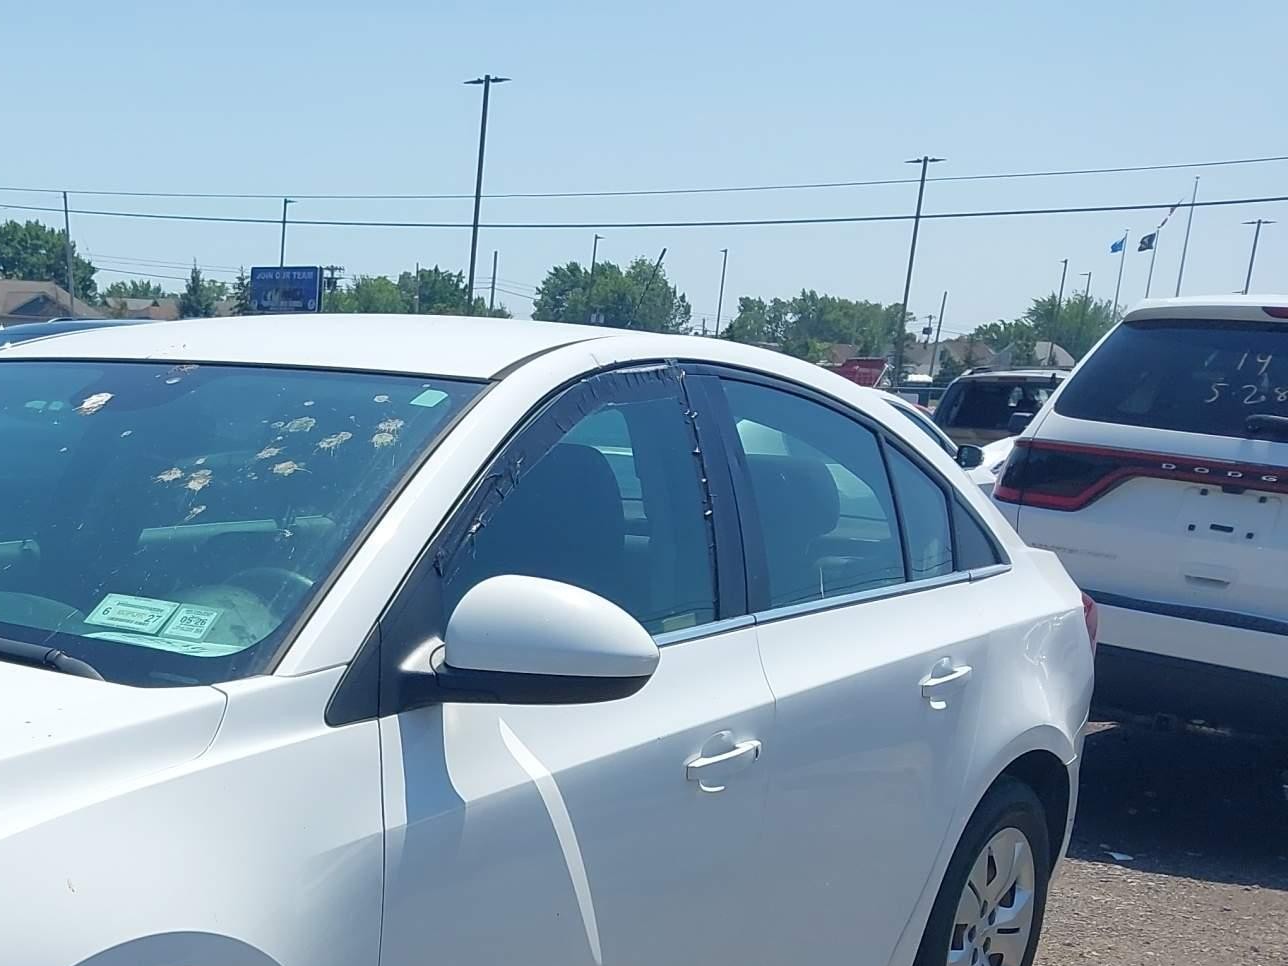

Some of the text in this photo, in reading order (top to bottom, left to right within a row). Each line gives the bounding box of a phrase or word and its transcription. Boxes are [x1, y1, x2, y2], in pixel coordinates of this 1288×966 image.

[292, 271, 314, 280] TEAM
[102, 606, 112, 615] 6
[143, 614, 163, 624] 27
